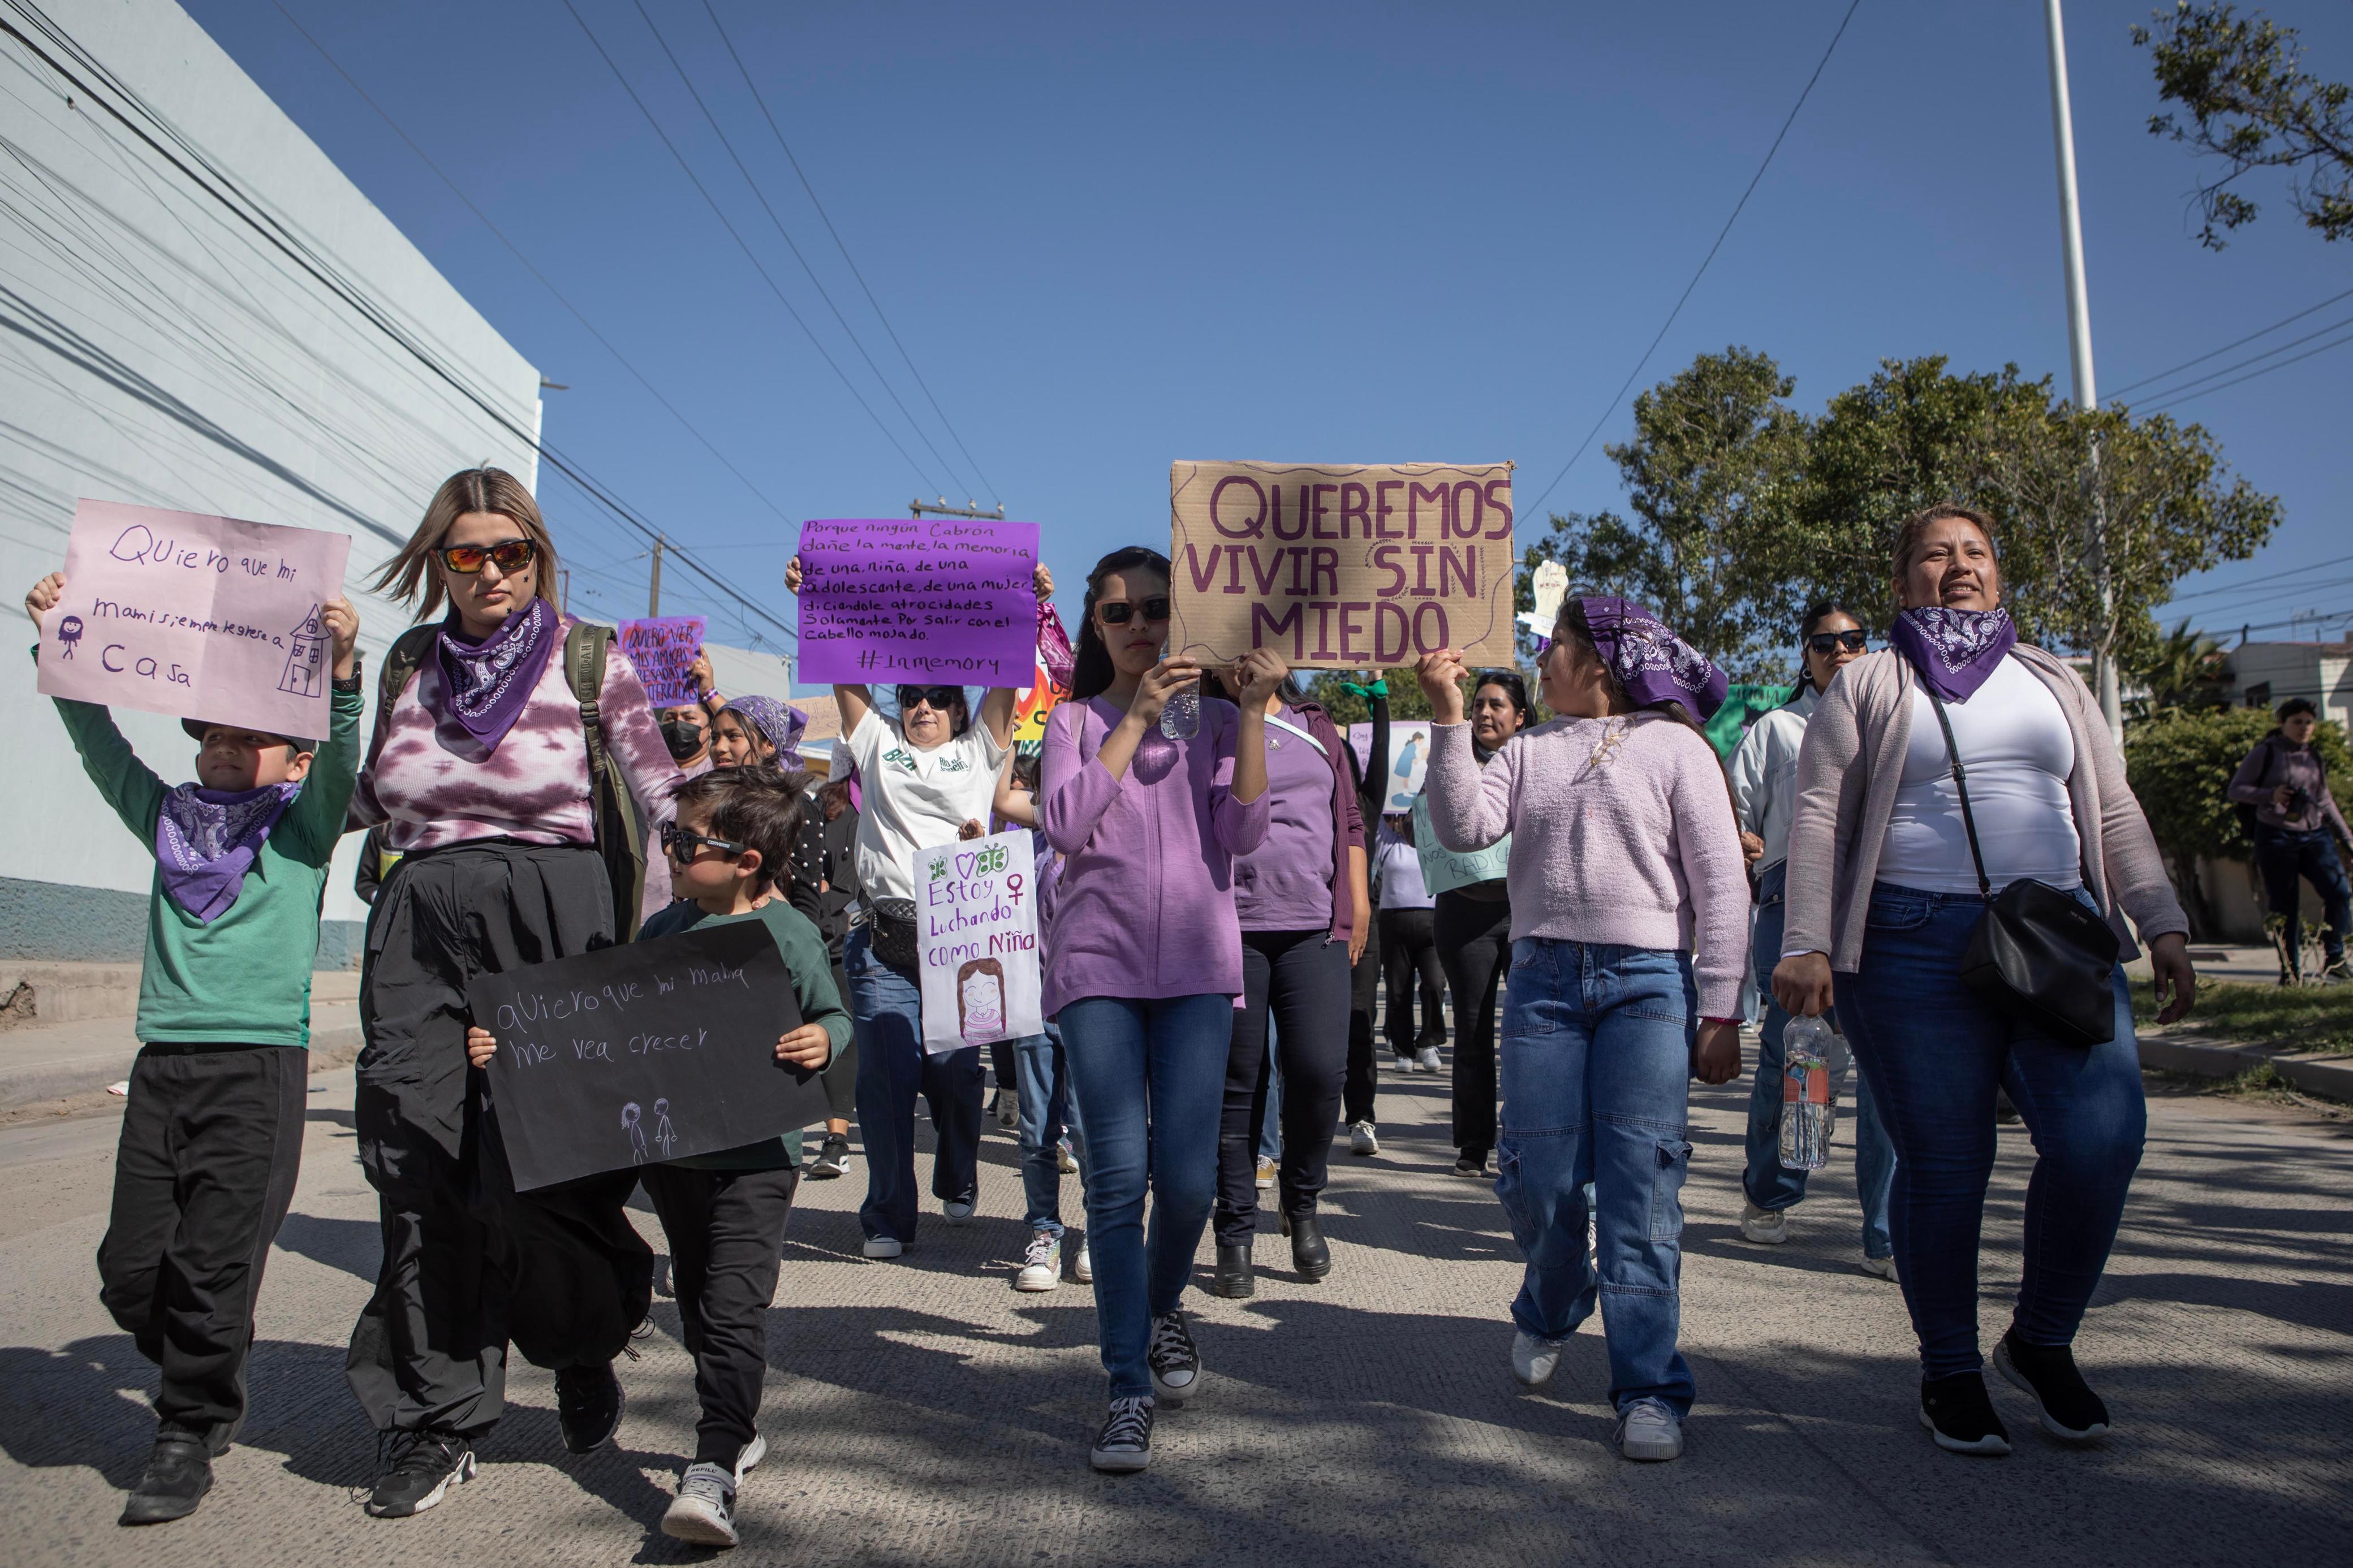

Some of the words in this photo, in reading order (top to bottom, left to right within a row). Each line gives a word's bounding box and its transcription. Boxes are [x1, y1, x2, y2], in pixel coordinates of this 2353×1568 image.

[1209, 476, 1512, 541] QUEREMOS
[806, 520, 859, 535] Porque
[865, 522, 919, 536] ningún
[929, 522, 995, 537] Cabrón
[801, 538, 851, 552] dañe
[856, 538, 874, 550] la
[933, 540, 950, 550] la
[954, 542, 1030, 559] memoria
[277, 559, 297, 582] mi
[804, 562, 826, 576] de
[915, 559, 933, 572] de
[938, 560, 969, 571] una
[1186, 543, 1339, 596] VIVIR
[1373, 545, 1477, 598] SIN
[923, 579, 943, 592] de
[947, 581, 977, 591] una
[981, 575, 1029, 590] mujer
[890, 598, 994, 610] atrocidades
[804, 627, 864, 640] Cabello
[869, 625, 929, 640] mojado.
[967, 617, 991, 627] con
[994, 616, 1010, 628] el
[1251, 601, 1449, 664] MIEDO
[223, 620, 268, 641] regrese
[272, 636, 285, 649] a
[628, 627, 665, 649] QUIERO
[670, 625, 694, 643] VER
[630, 650, 649, 667] MIS
[707, 840, 731, 849] CONVERSE
[1422, 848, 1447, 865] NOS
[928, 880, 993, 907] Estoy
[930, 894, 1012, 937] Luchando
[928, 943, 980, 967] como
[989, 930, 1035, 956] Niña
[602, 980, 644, 1012] que
[653, 974, 675, 996] mi
[509, 1039, 557, 1069] me
[572, 1038, 615, 1062] vea
[628, 1027, 707, 1055] crecer
